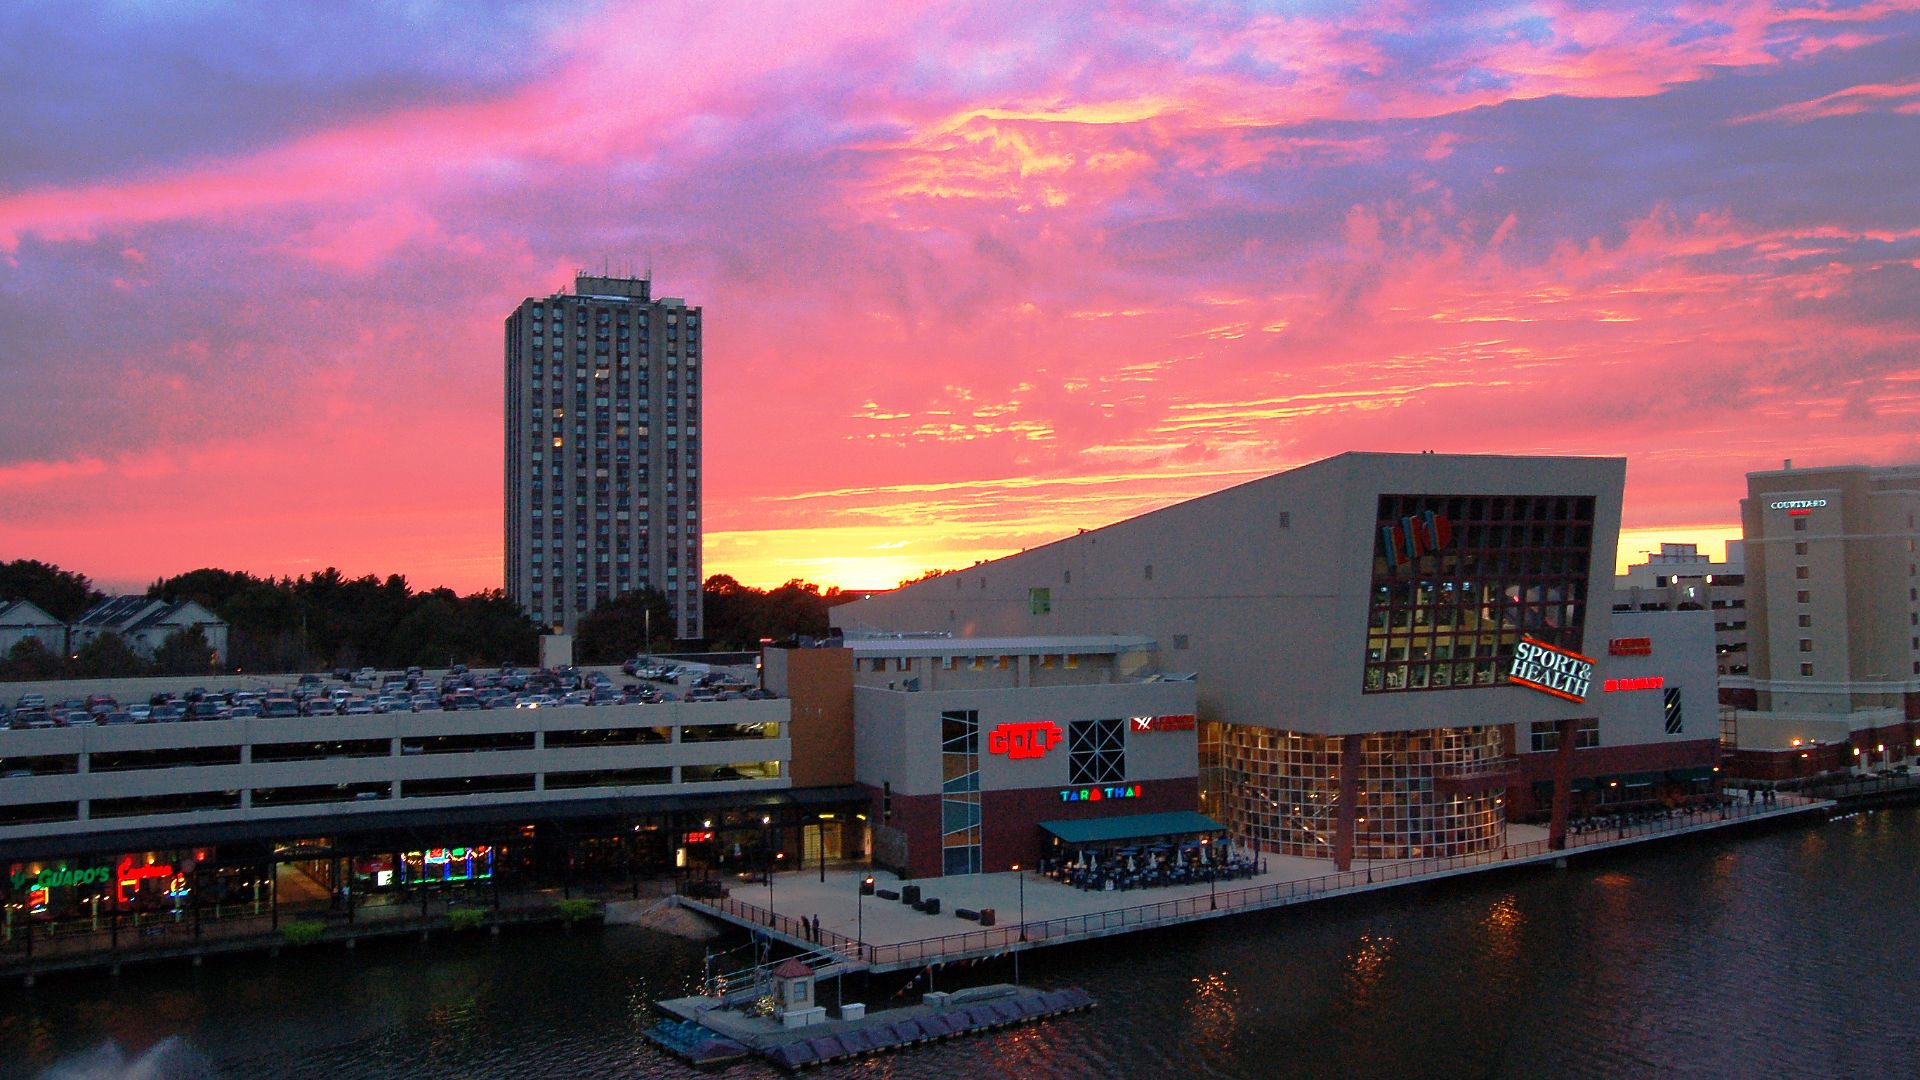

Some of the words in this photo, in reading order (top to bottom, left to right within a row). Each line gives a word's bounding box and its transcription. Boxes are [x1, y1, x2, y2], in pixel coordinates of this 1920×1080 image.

[1771, 499, 1826, 509] COURTYARD
[1510, 659, 1589, 698] HEALTH
[989, 721, 1062, 759] GOLF
[1060, 788, 1101, 801] TARA
[1104, 785, 1141, 799] THAI
[38, 866, 110, 889] GUAPO'S
